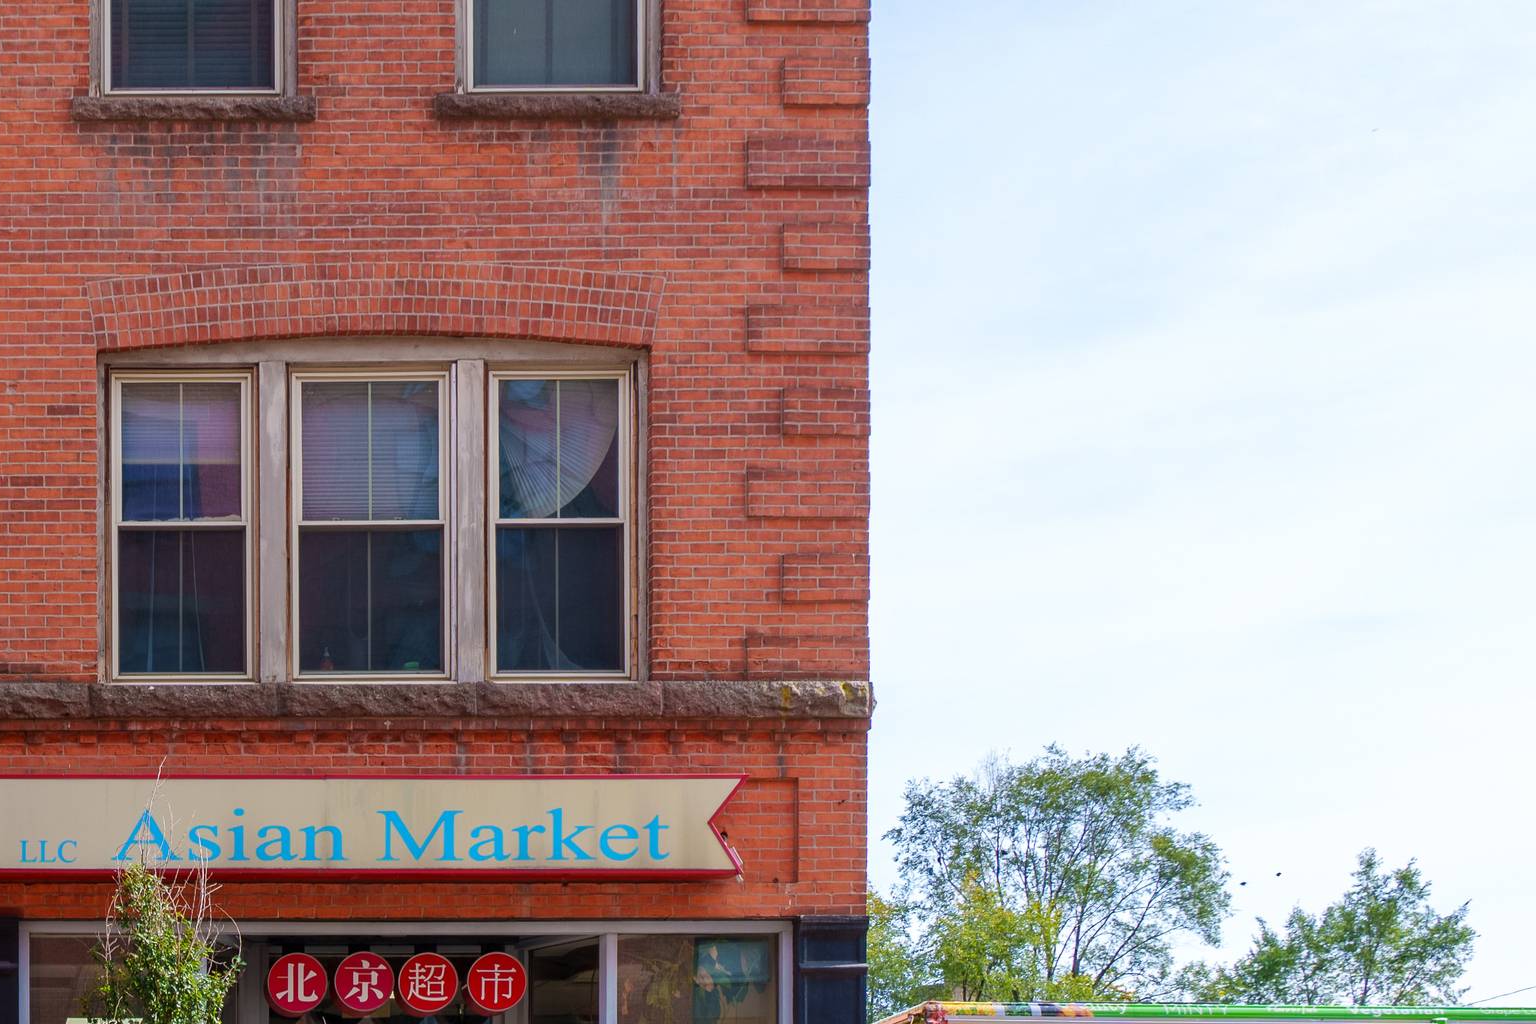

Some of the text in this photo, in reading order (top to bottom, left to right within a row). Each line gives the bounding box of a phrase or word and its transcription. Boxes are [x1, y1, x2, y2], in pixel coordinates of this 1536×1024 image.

[19, 840, 77, 863] LLC
[111, 808, 348, 862] Asian
[376, 807, 670, 862] Market
[276, 959, 517, 1004] 北京超市
